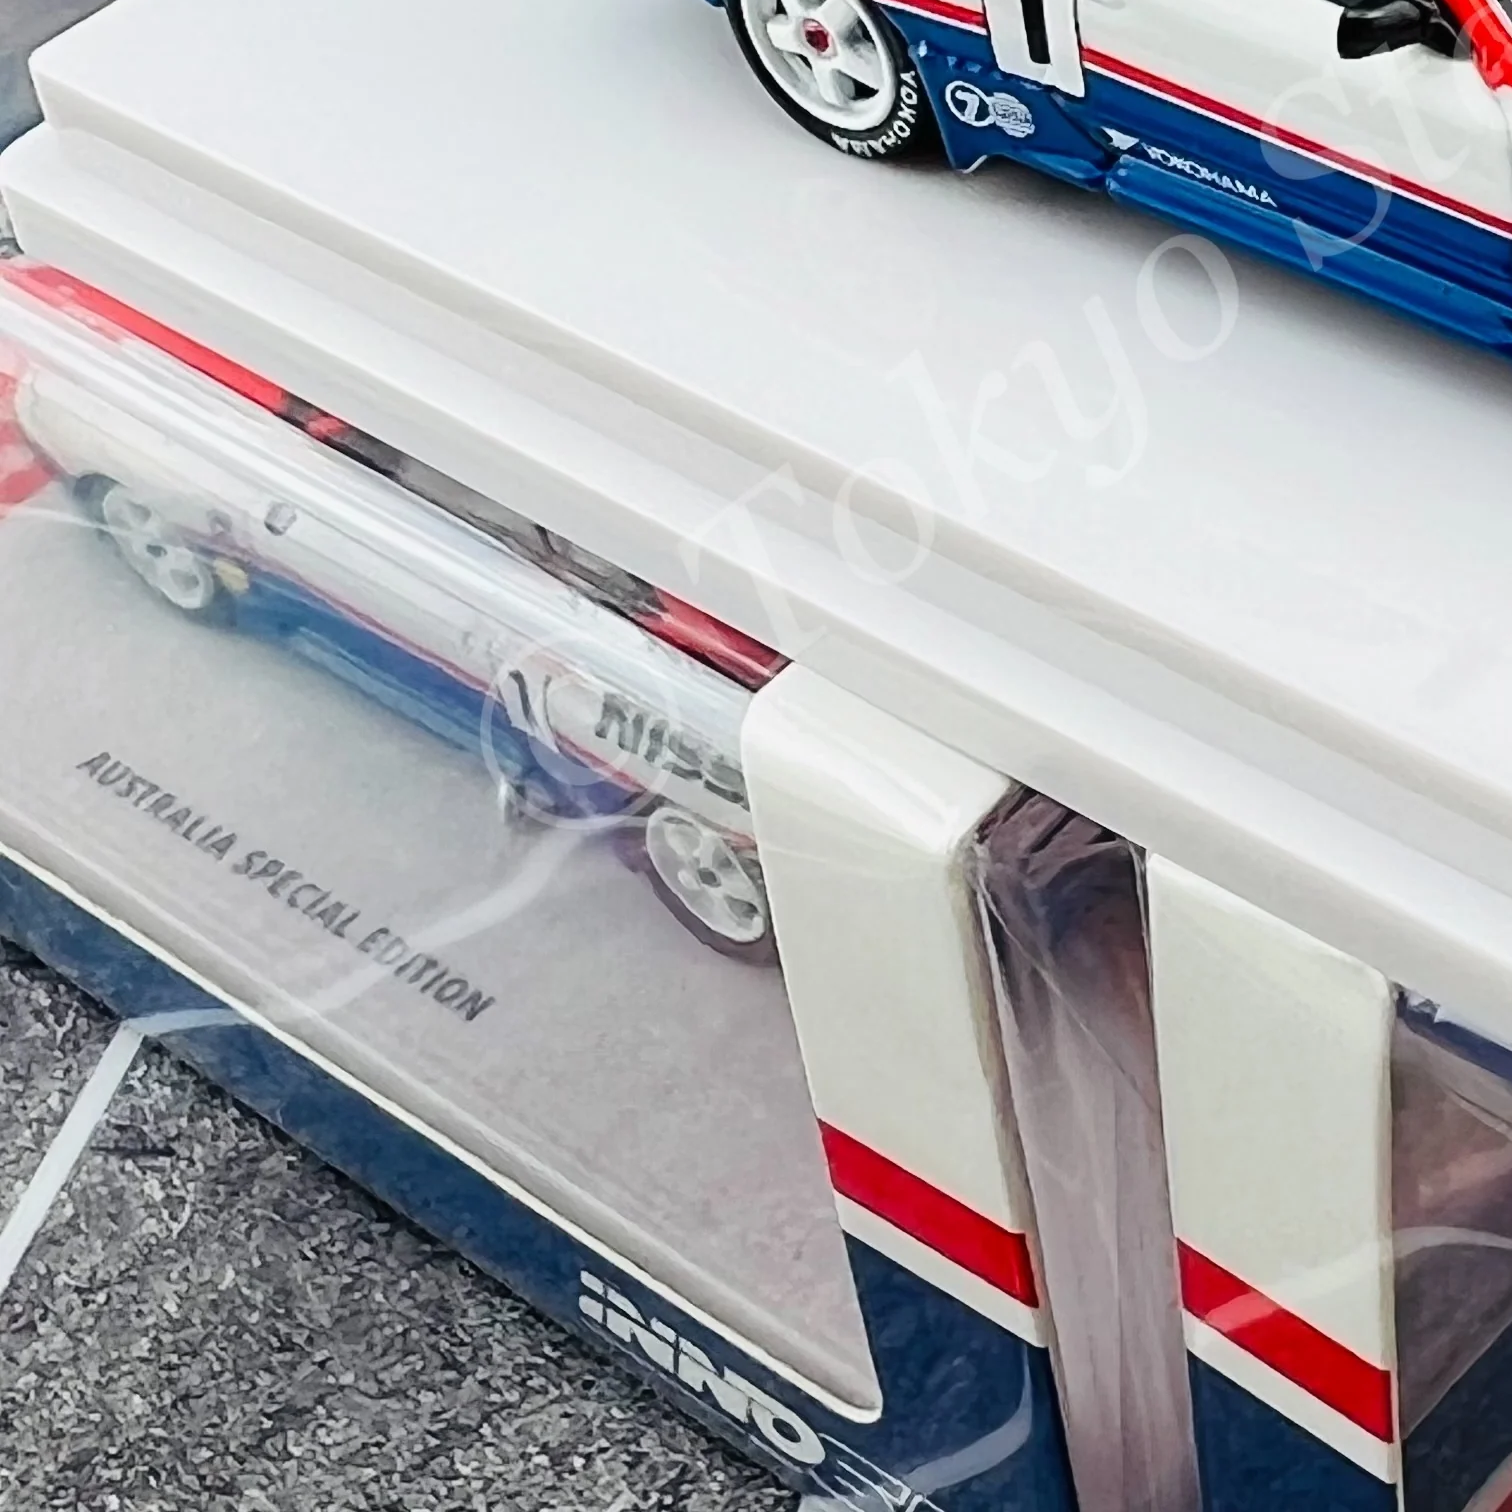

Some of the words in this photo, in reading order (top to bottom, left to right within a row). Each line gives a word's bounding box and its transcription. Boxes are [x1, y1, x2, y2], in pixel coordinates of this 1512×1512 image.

[76, 752, 238, 861] AUSTRALIA
[231, 849, 361, 939] SPECIAL
[356, 926, 497, 1022] EDITION
